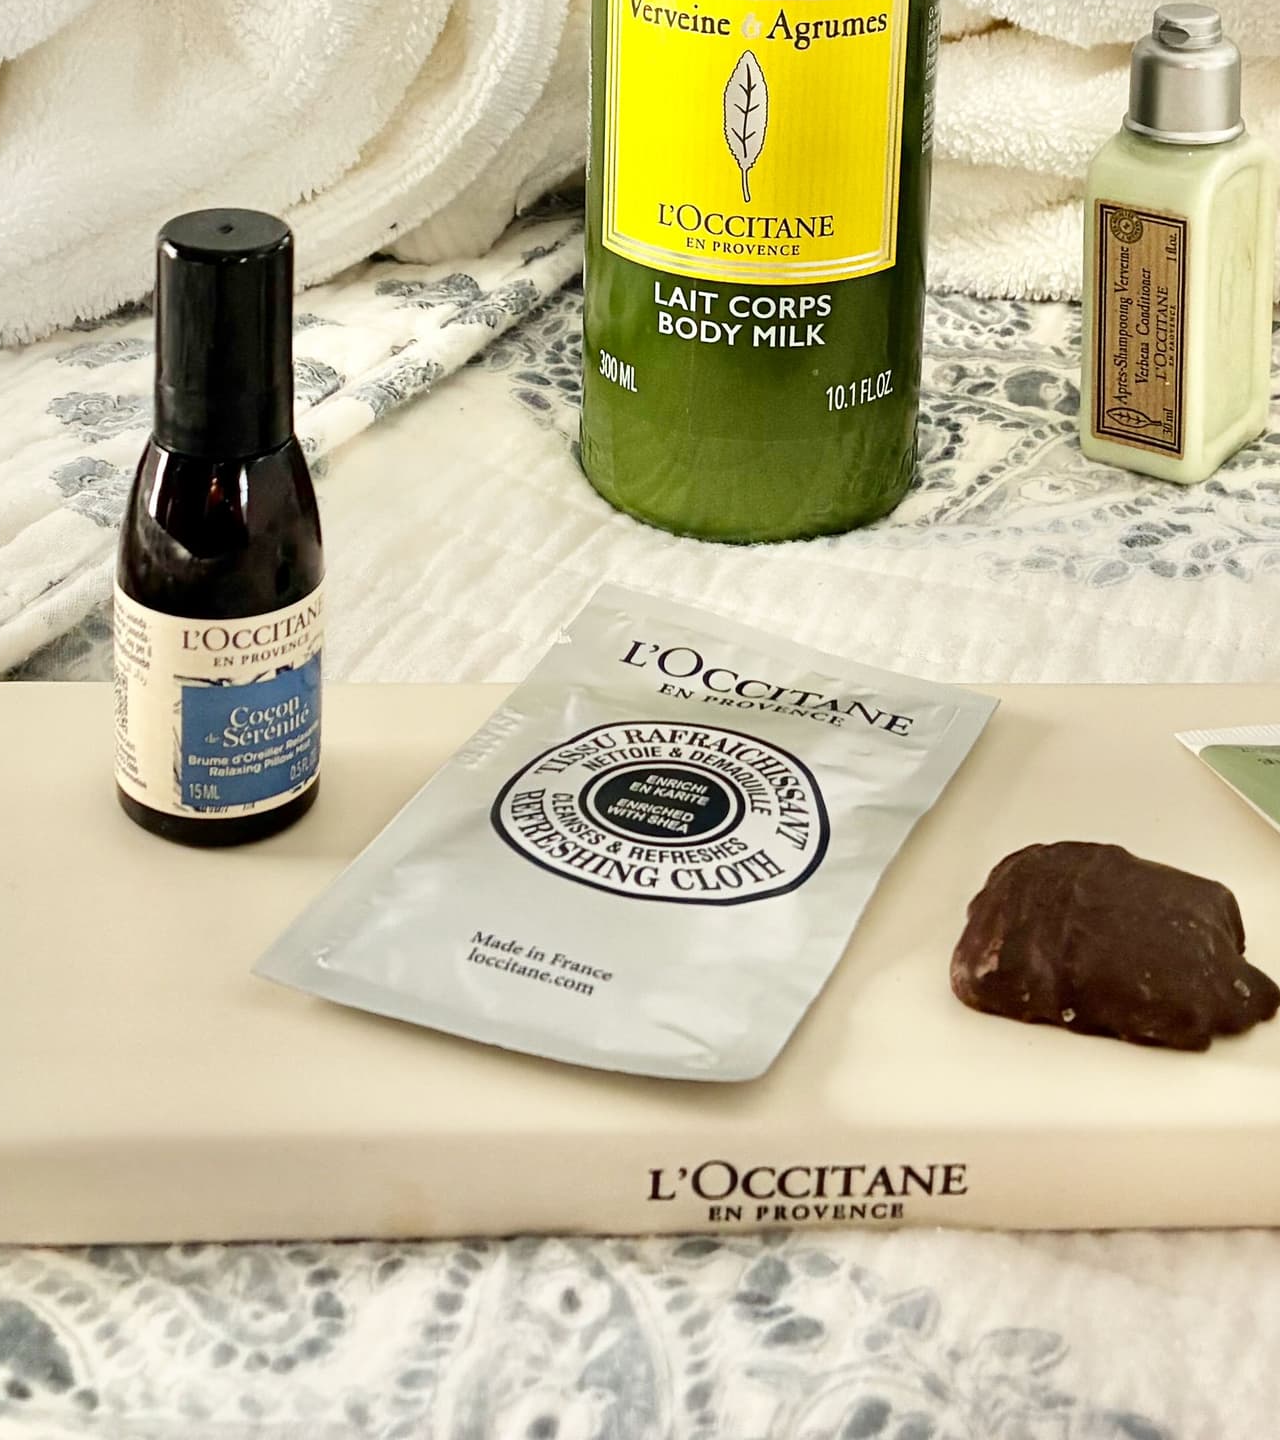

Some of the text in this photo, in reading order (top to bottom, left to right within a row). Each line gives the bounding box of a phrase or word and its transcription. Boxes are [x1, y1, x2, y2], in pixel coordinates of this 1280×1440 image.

[766, 9, 888, 50] Agrumes
[658, 203, 835, 239] L'OCCITANE
[686, 237, 801, 257] EN PROVENCE
[654, 281, 832, 320] LAIT CORPS
[658, 311, 826, 348] BODY MILK
[1135, 267, 1152, 384] Verbena Conditioner
[1153, 286, 1169, 382] L'OCCITANE
[598, 349, 638, 393] 300 ML
[825, 381, 857, 412] 10.1
[1163, 408, 1174, 438] 30 ml
[213, 633, 310, 668] EN PROVENCE
[619, 640, 914, 737] L'OCCITANE
[657, 683, 846, 728] EN PROVENCE
[188, 754, 229, 767] Brume
[209, 763, 262, 777] Relaxing
[189, 783, 221, 801] 15 ML
[533, 733, 617, 775] TISSU
[622, 728, 810, 851] RAFRAICHISSANT
[581, 746, 772, 816] NETTOIE & DEMAQUILLE
[629, 781, 711, 807] EN KARITE
[645, 774, 709, 795] ENRICHI
[552, 792, 749, 864] CLEANSES & REFRESHES
[607, 805, 689, 835] WITH SHEA
[616, 798, 695, 823] ENRICHED
[511, 788, 786, 891] REFRESHING CLOTH
[466, 947, 595, 997] loccitane.com
[470, 931, 614, 982] Made in France
[647, 1159, 968, 1201] L'OCCITANE
[708, 1203, 905, 1222] EN PROVENCE
